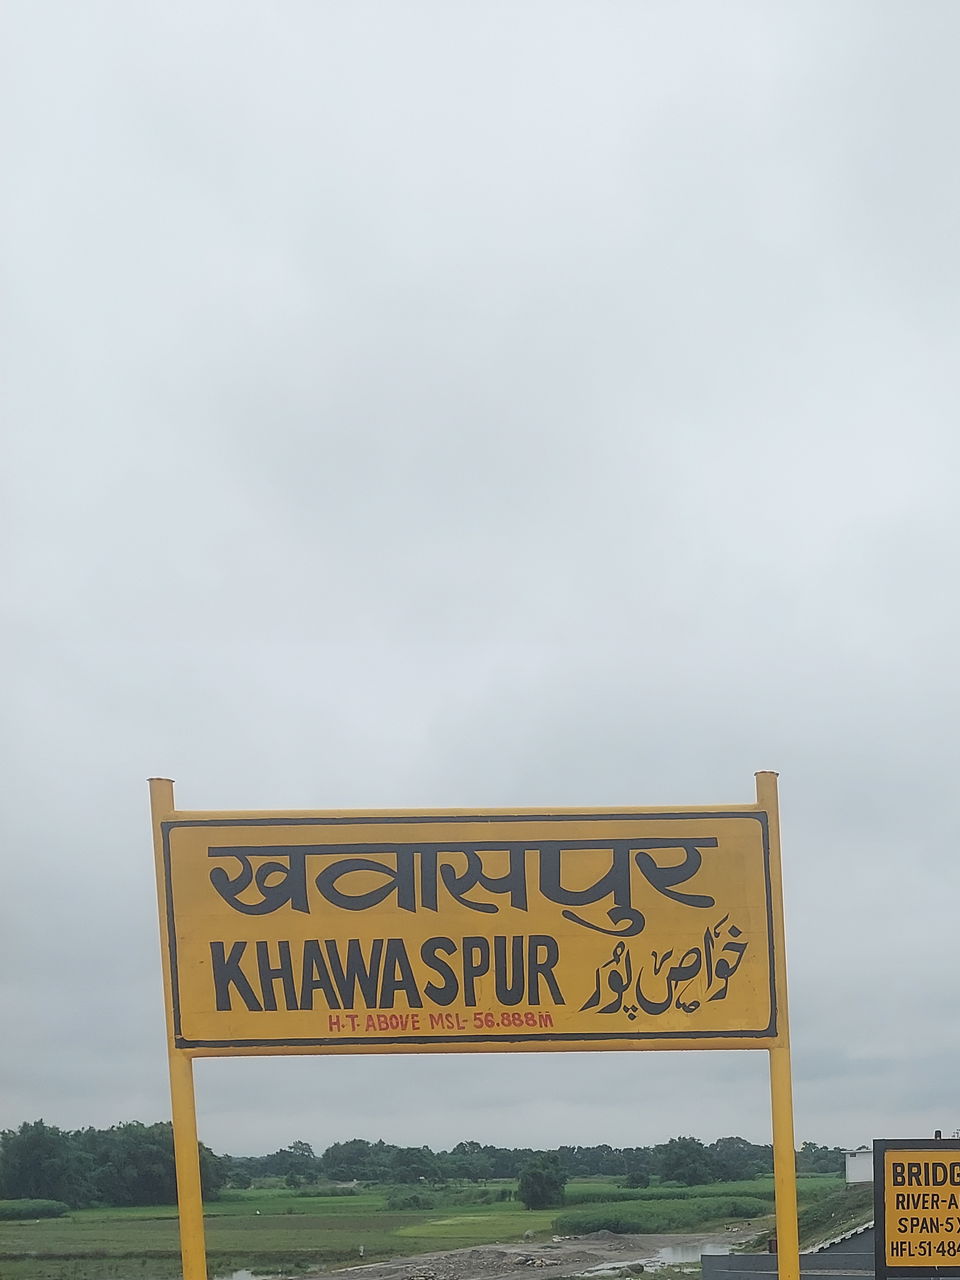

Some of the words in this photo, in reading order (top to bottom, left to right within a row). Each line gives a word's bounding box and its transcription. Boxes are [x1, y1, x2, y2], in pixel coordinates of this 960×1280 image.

[207, 836, 718, 938] खवासपुर
[209, 934, 566, 1012] KHAWASPUR
[364, 1013, 421, 1032] ABOVE
